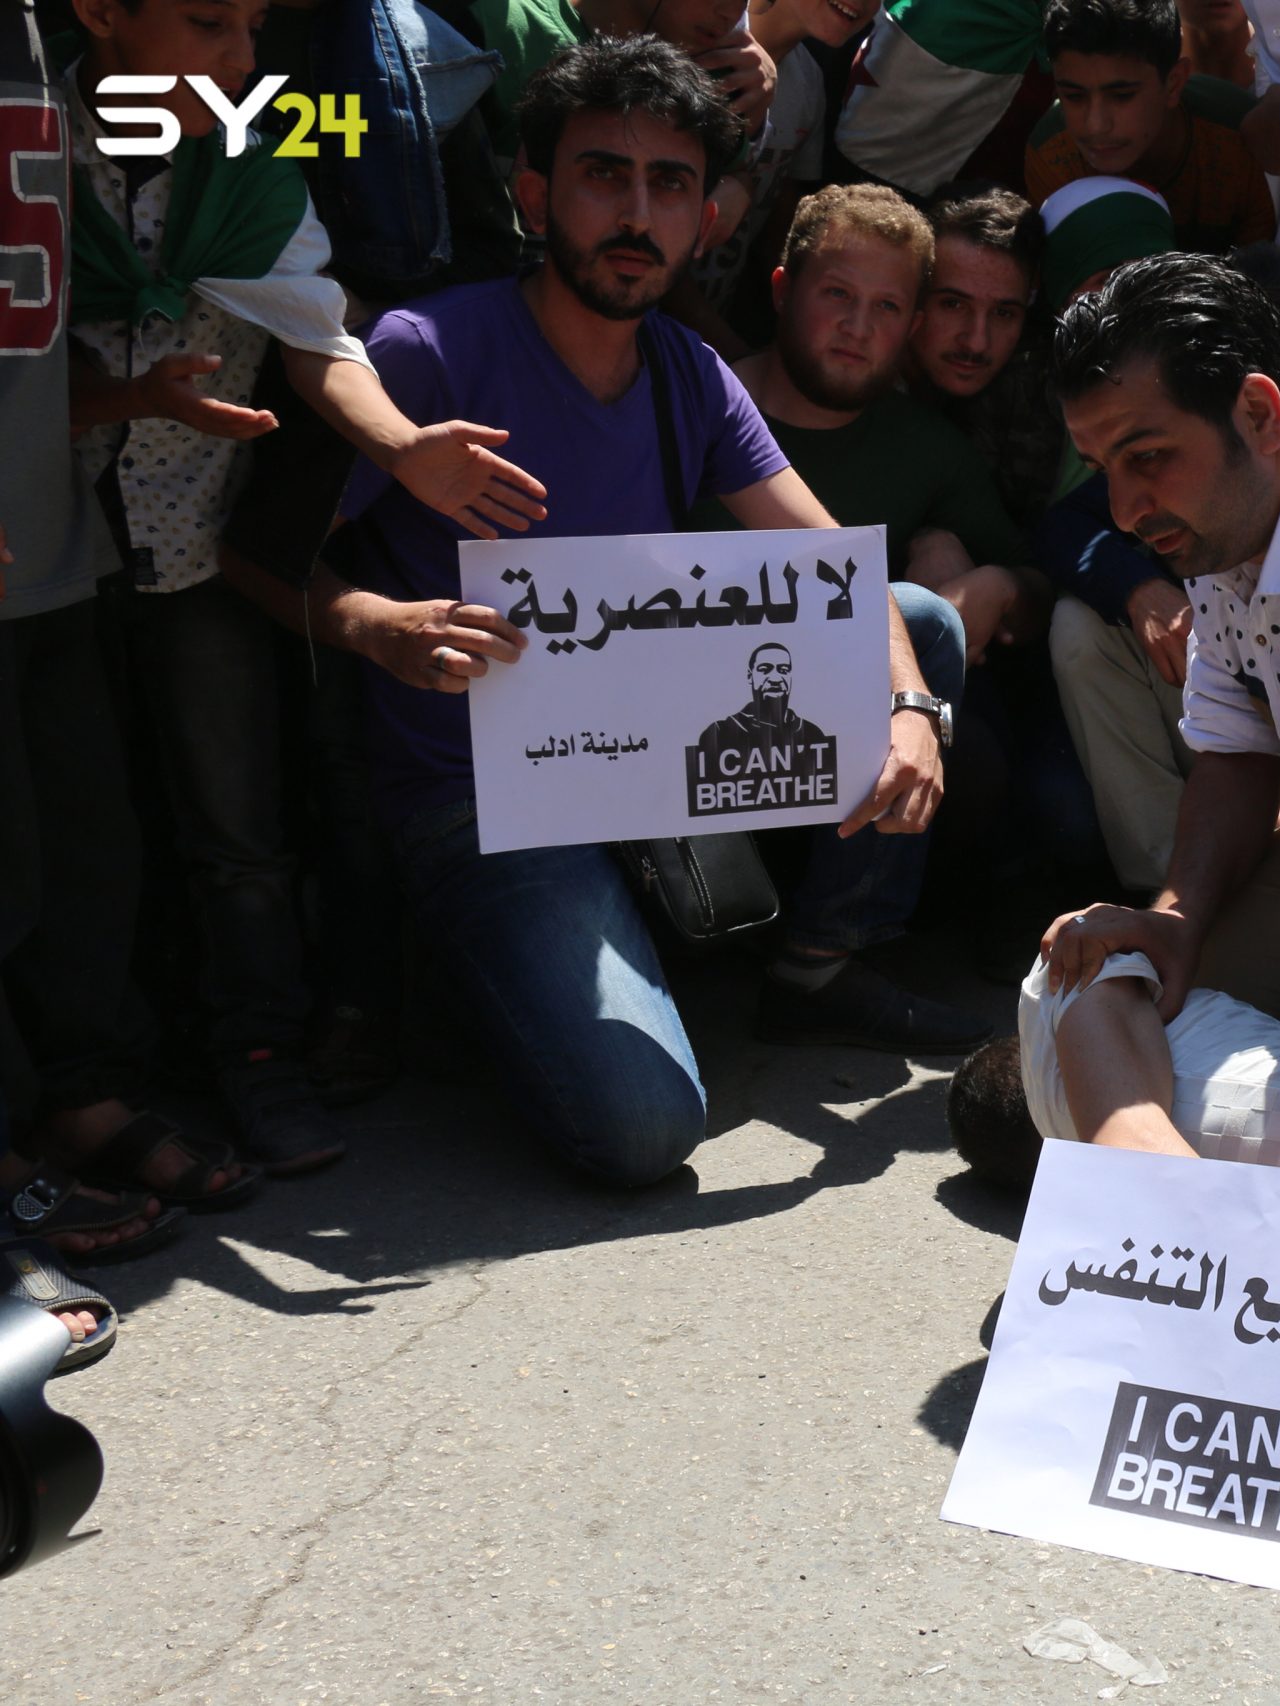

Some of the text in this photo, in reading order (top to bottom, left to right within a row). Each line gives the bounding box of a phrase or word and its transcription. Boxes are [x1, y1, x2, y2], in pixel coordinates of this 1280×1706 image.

[500, 556, 858, 656] لا للعنصرية
[525, 731, 649, 766] مدينة ادلب
[698, 742, 829, 778] I CAN'T
[696, 773, 834, 810] BREATHE
[1038, 1237, 1228, 1312] التنفس
[1127, 1395, 1148, 1443] I
